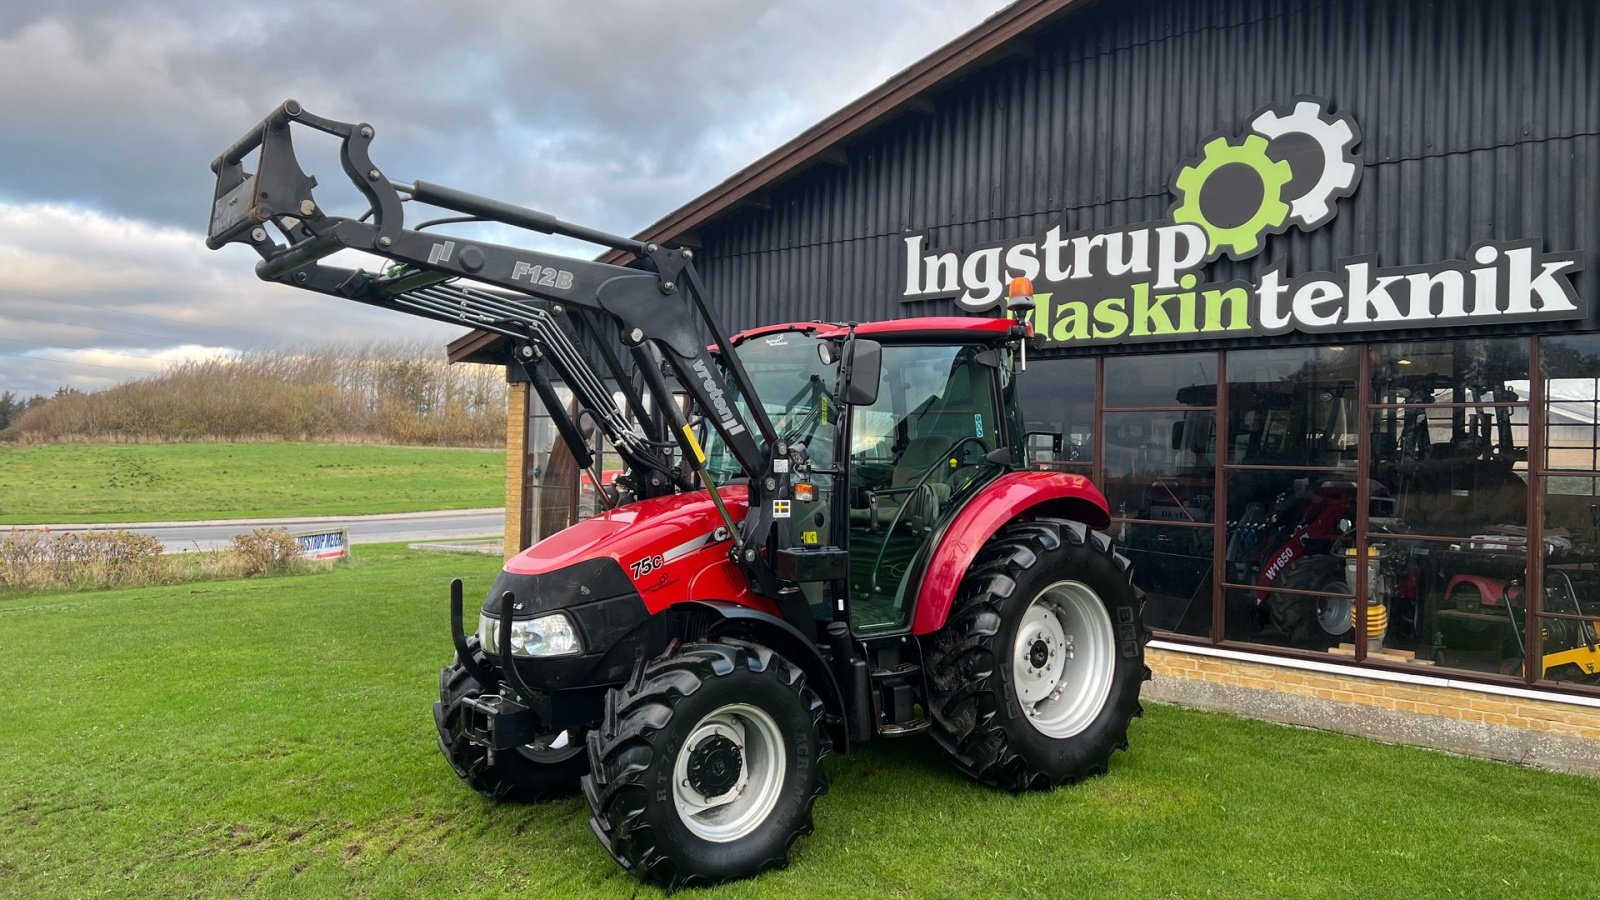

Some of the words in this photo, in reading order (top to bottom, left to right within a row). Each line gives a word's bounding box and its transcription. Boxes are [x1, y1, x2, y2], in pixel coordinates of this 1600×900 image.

[511, 260, 574, 289] F12B
[903, 224, 1207, 305] Ingstrup
[629, 554, 663, 581] 75C
[1265, 547, 1294, 581] W1650
